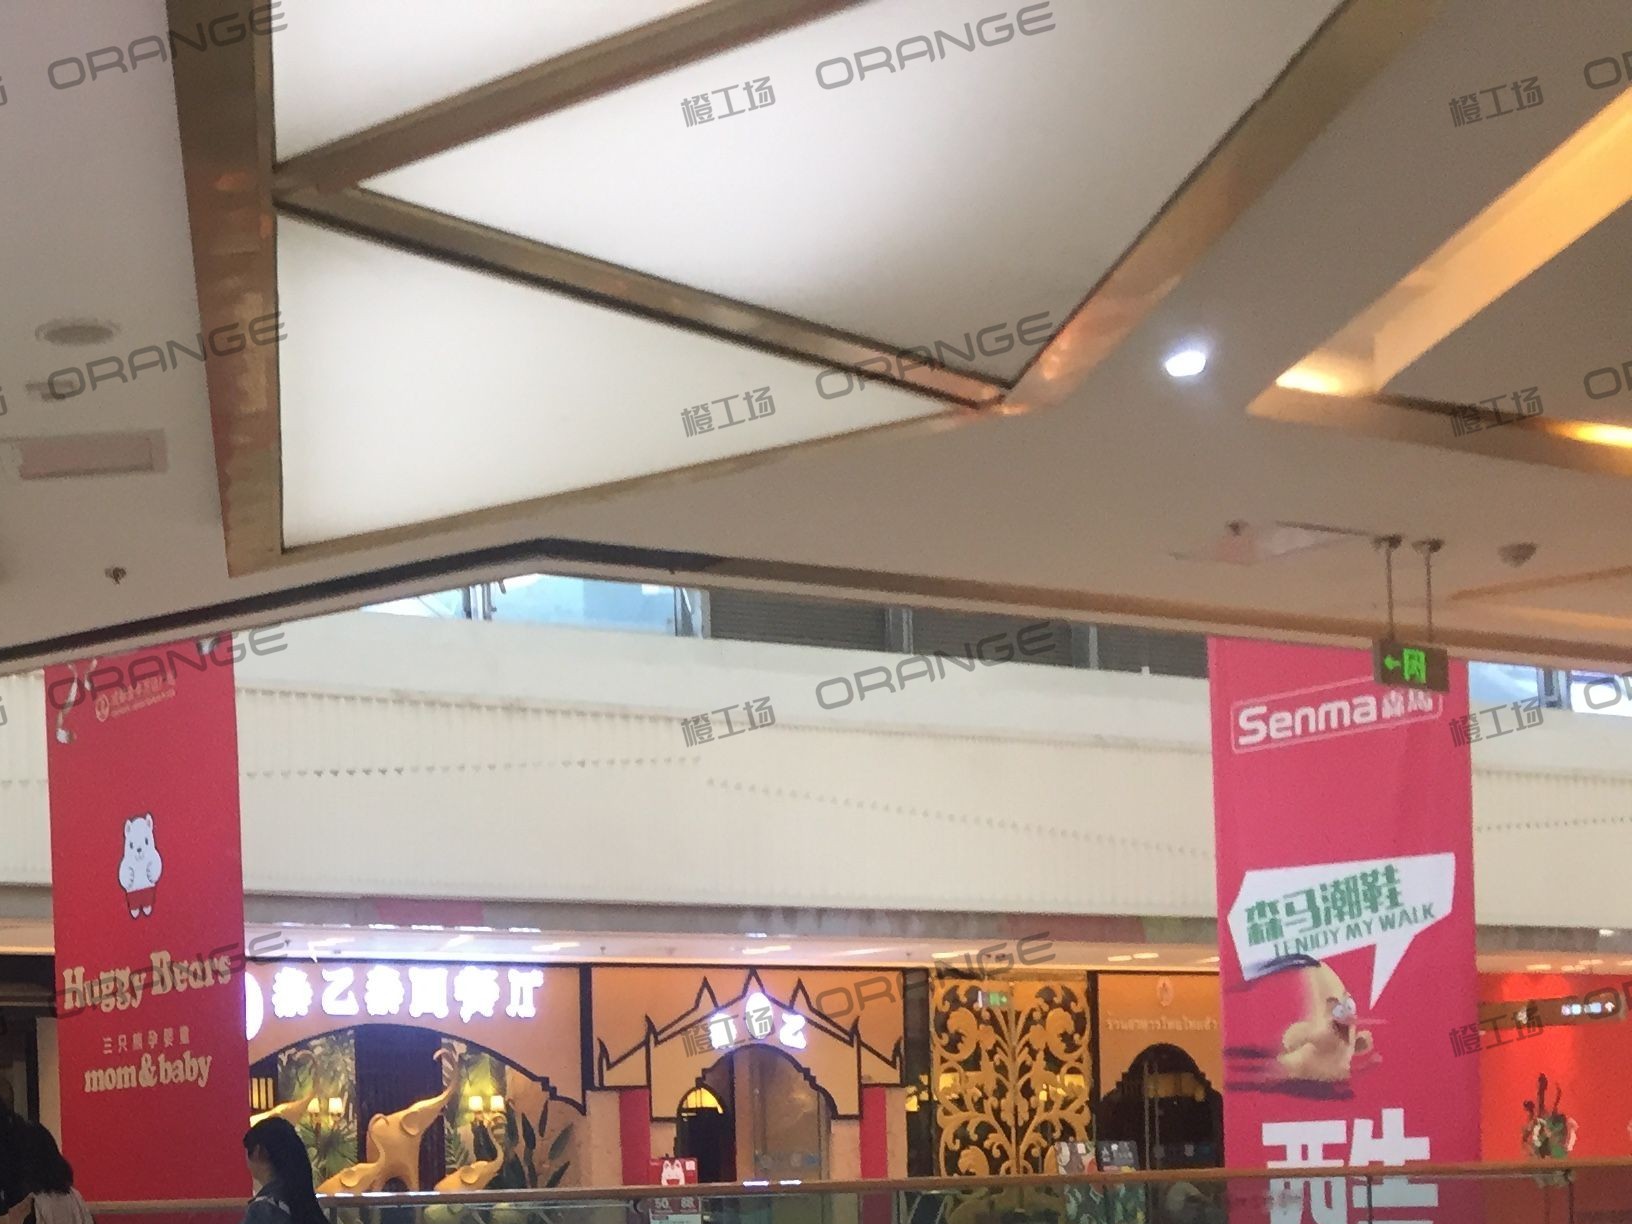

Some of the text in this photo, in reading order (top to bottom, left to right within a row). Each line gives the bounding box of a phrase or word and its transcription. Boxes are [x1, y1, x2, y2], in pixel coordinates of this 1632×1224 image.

[1238, 695, 1377, 746] Senma
[1245, 864, 1404, 947] 森马潮鞋
[1345, 917, 1373, 942] MY
[1378, 902, 1436, 933] WALK
[62, 950, 232, 1013] Huggy Bears
